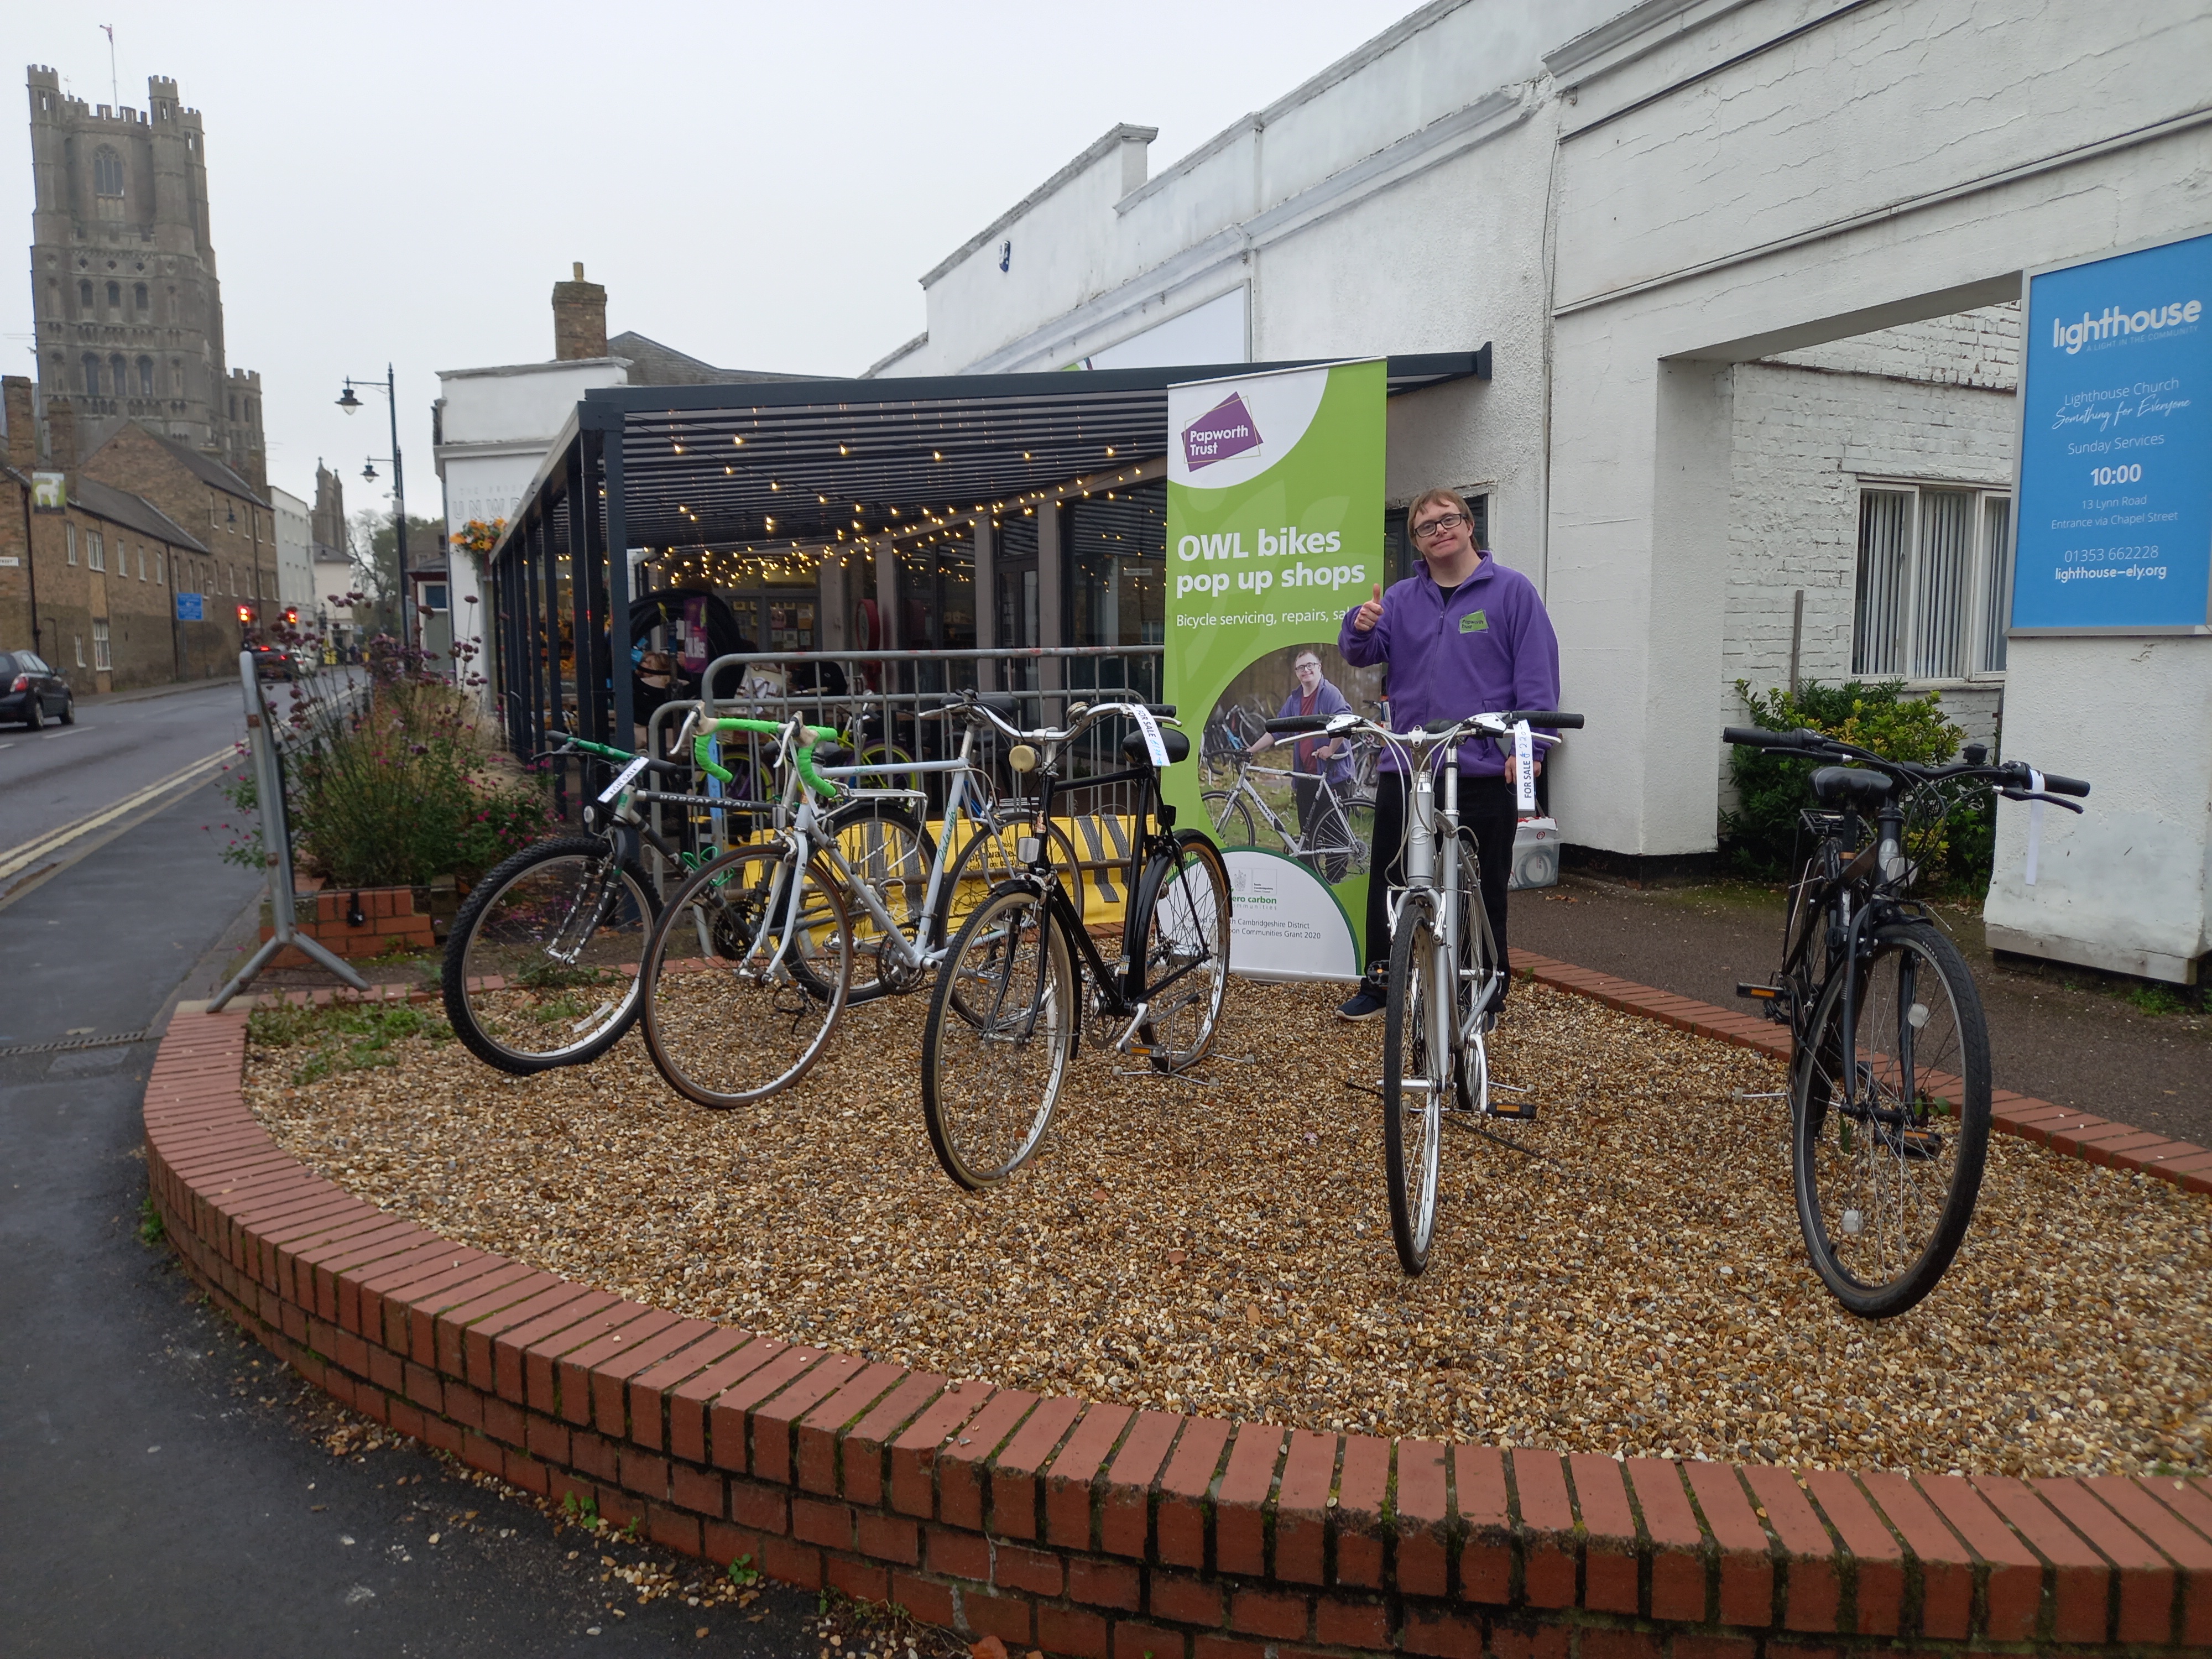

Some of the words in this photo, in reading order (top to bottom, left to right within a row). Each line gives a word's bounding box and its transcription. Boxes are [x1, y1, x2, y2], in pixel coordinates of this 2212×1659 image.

[2053, 300, 2202, 354] lighthouse
[2094, 340, 2116, 351] LIGHT
[2119, 338, 2127, 346] IN
[2130, 334, 2145, 343] THE
[2148, 325, 2198, 342] COMMUNITY
[2064, 387, 2130, 407] Lighthouse
[2133, 378, 2179, 395] Church
[2052, 404, 2111, 432] Something
[2114, 401, 2133, 426] for
[2137, 394, 2192, 417] Everyone
[1190, 425, 1249, 446] Papworth
[2068, 440, 2111, 455] Sunday
[2114, 434, 2164, 450] Services
[1190, 442, 1218, 456] Trust
[2090, 463, 2142, 486] 10:00
[2082, 500, 2094, 509] 13
[2096, 498, 2119, 510] Lynn
[2122, 495, 2147, 506] Road
[2052, 519, 2093, 529] Entrance
[2095, 517, 2108, 526] via
[2110, 513, 2145, 526] Chapel
[2148, 512, 2178, 523] Street
[1178, 532, 1249, 561] OWL
[1258, 526, 1341, 557] bikes
[2064, 549, 2105, 562] 01353
[2109, 545, 2159, 561] 662228
[1177, 574, 1229, 599] pop
[1238, 571, 1273, 595] up
[1281, 562, 1365, 591] shops
[2055, 564, 2167, 583] lighthouse-ely.org
[1176, 614, 1217, 629] Bicycle
[1220, 609, 1277, 626] servicing,
[1281, 608, 1329, 624] repairs,
[1333, 607, 1349, 620] sal
[1136, 709, 1149, 721] FOR
[1143, 721, 1156, 738] SALE
[1523, 760, 1531, 780] SALE
[1248, 896, 1277, 904] carbon
[1238, 918, 1286, 928] Cambridgeshire
[1287, 921, 1310, 929] District
[1241, 928, 1282, 937] Communities
[1284, 930, 1303, 938] Grant
